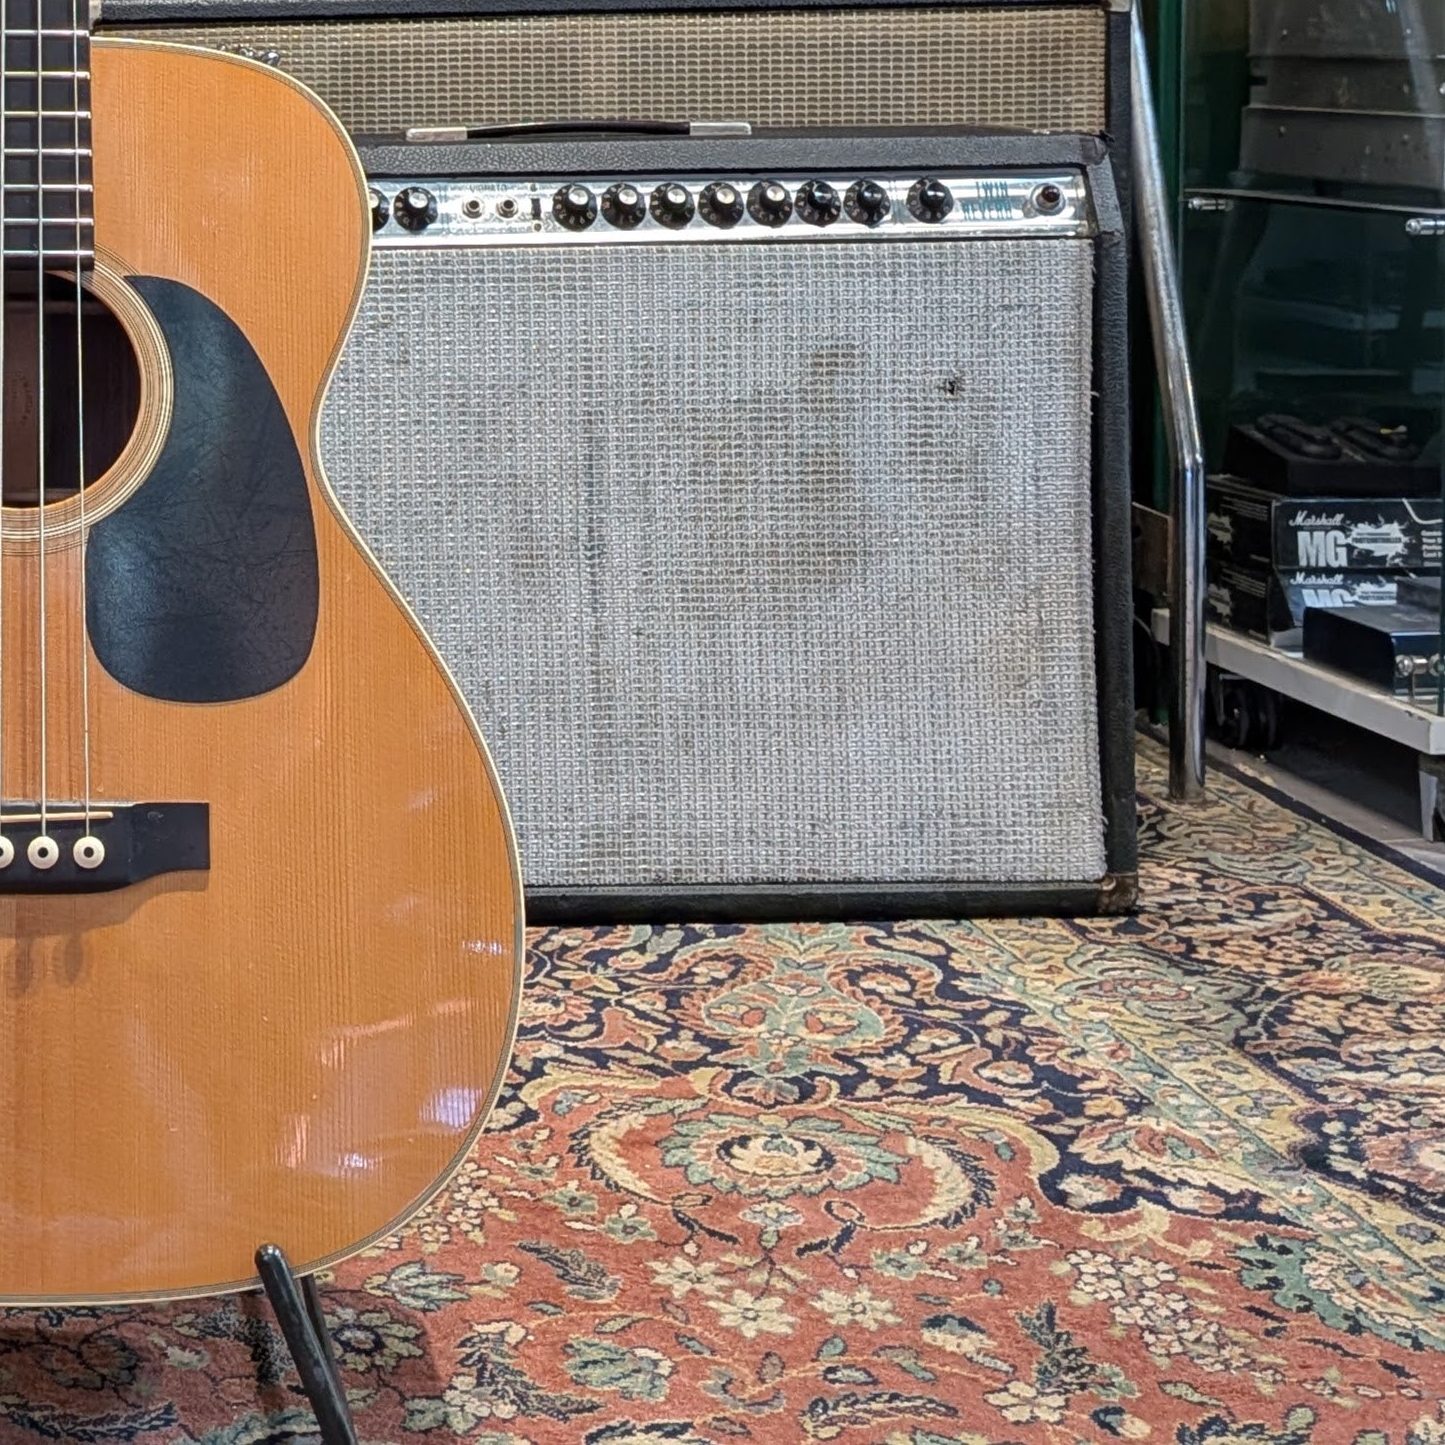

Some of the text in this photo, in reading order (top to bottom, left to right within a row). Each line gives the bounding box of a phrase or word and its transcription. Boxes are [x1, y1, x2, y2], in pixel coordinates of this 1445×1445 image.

[1288, 510, 1345, 527] Marshall
[1297, 530, 1348, 568] MG
[1289, 571, 1344, 585] Marshall
